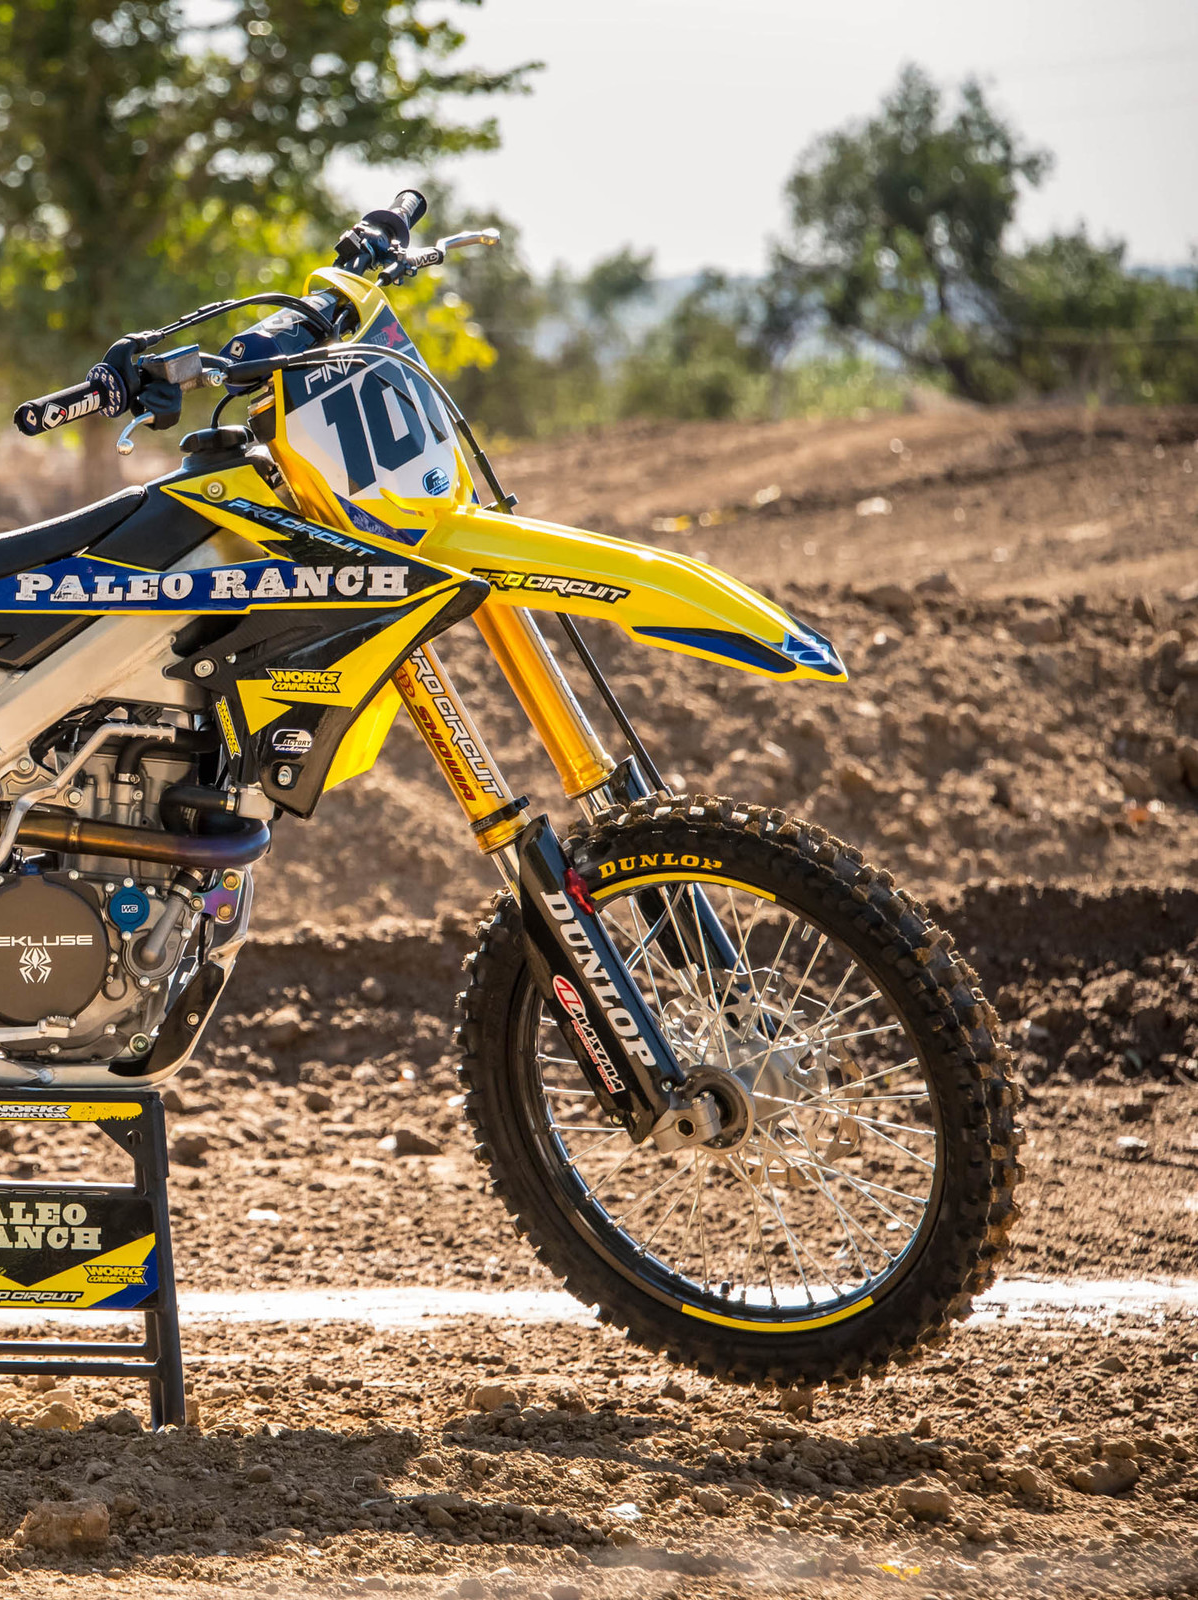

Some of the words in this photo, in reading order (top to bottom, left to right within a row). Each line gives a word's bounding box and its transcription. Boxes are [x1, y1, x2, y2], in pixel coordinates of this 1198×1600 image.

[321, 361, 450, 496] 101
[228, 500, 283, 522] PRO
[278, 517, 377, 557] CIRCUIT
[15, 572, 194, 602] PALEO
[210, 566, 409, 599] RANCH
[523, 572, 630, 602] CIRCUIT
[269, 670, 342, 685] WORKS
[273, 682, 341, 693] CONNECTION
[414, 704, 476, 801] SHOWA
[432, 696, 505, 798] CIRCUIT
[598, 853, 723, 879] DUNLOP
[540, 890, 657, 1067] DUNLOP
[84, 1265, 148, 1277] WORKS
[88, 1274, 147, 1285] CONNECTION
[8, 1290, 83, 1302] CIRCUIT
